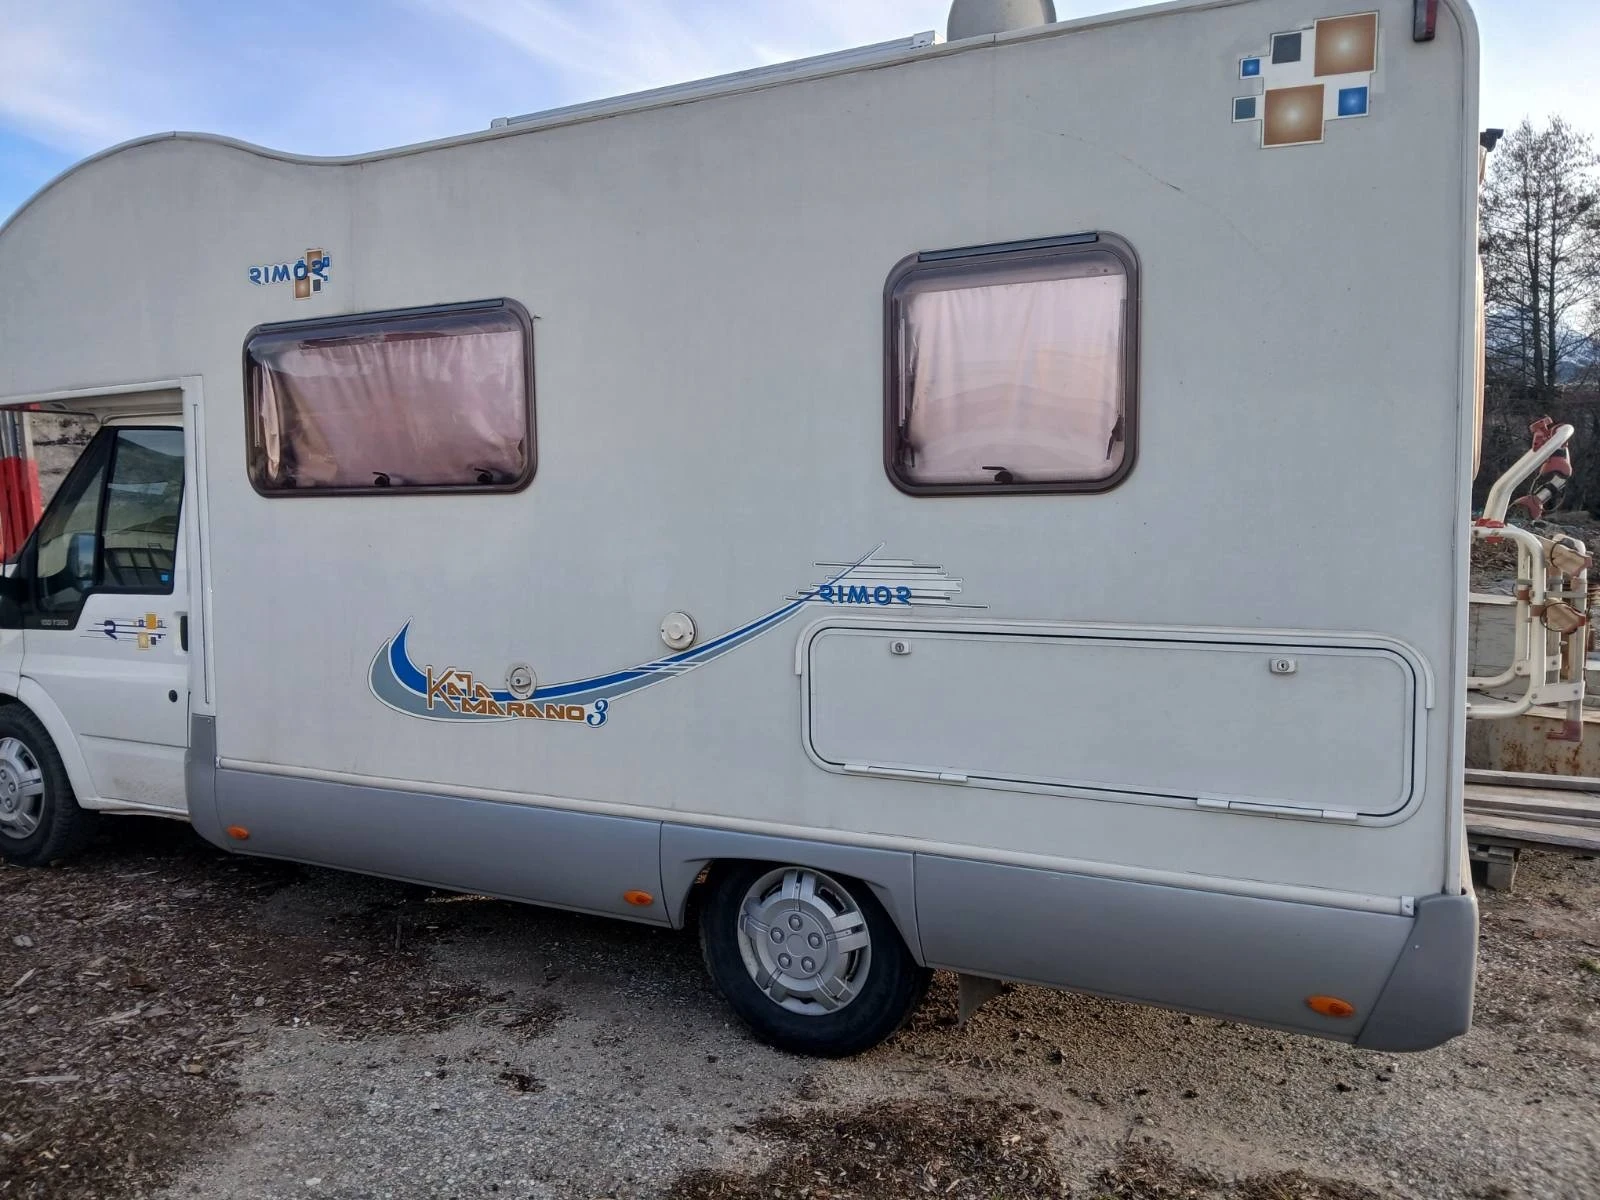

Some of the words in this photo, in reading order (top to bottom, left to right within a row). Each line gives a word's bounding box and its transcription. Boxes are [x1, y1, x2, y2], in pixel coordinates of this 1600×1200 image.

[249, 259, 328, 285] RIMOR
[819, 584, 912, 606] RIMOR
[586, 699, 609, 726] 3
